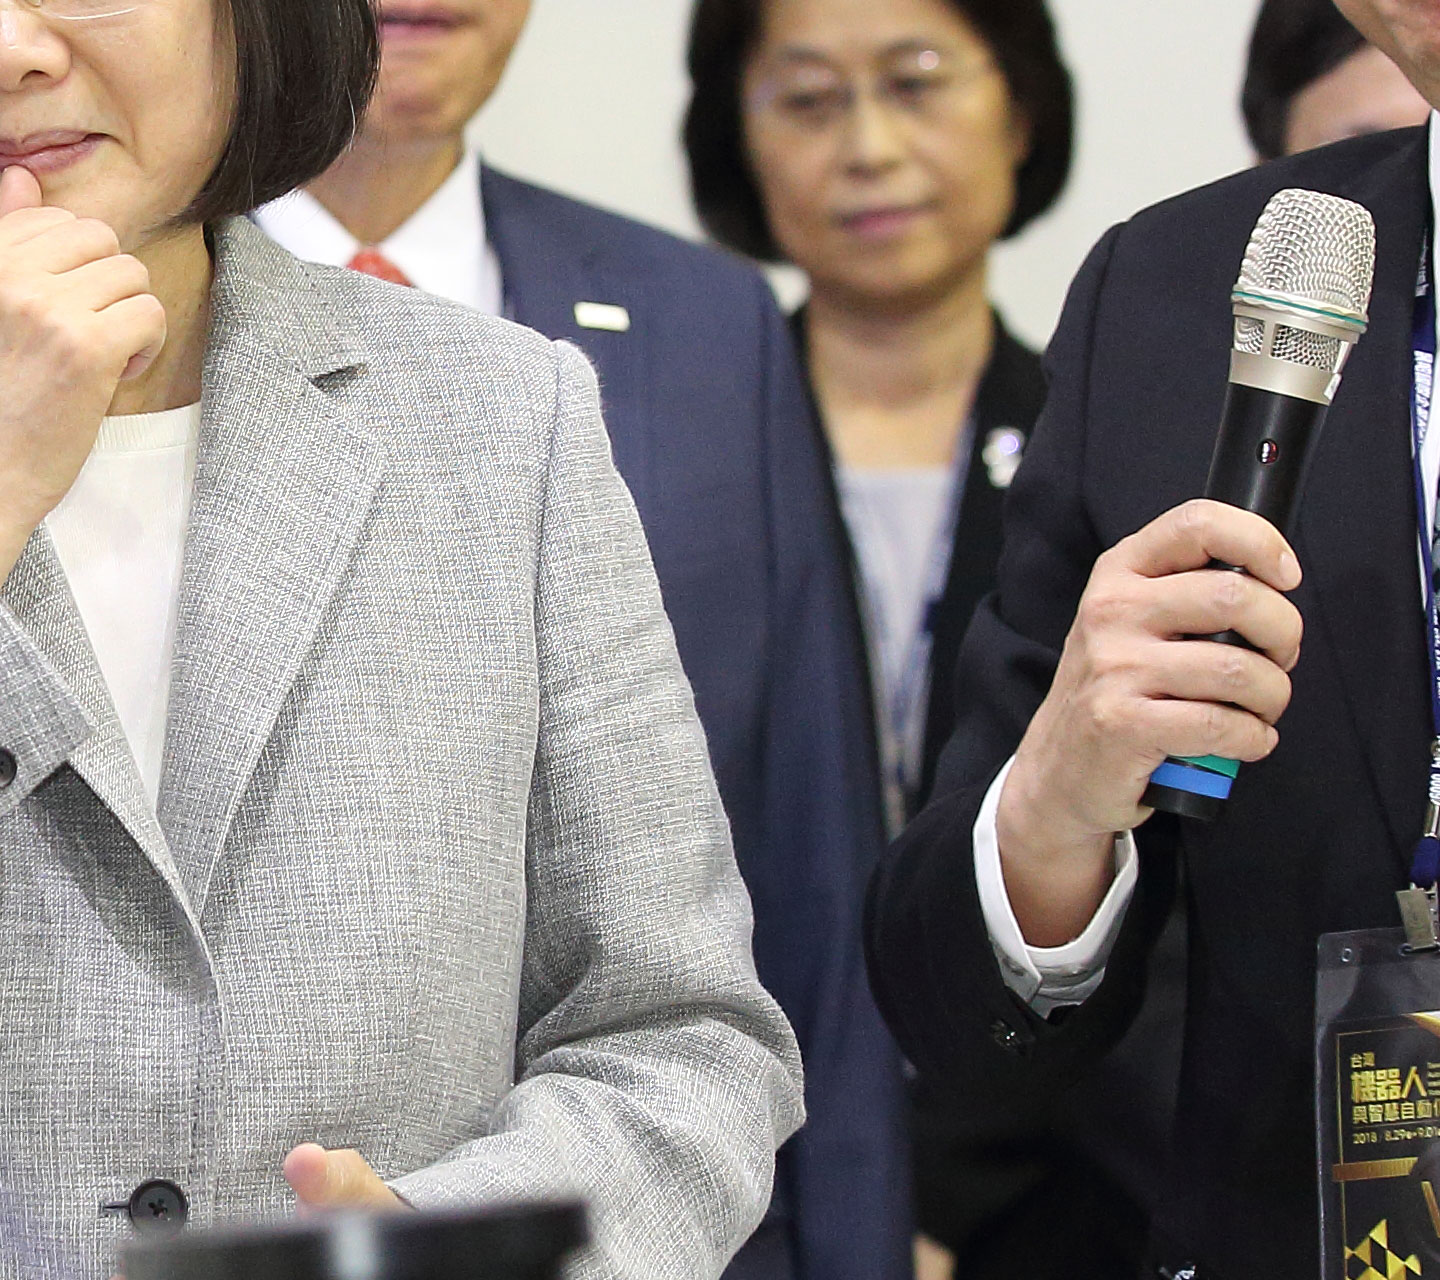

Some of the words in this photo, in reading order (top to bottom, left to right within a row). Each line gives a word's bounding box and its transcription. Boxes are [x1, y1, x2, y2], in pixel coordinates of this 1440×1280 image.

[1350, 1051, 1375, 1069] 台灣
[1350, 1065, 1428, 1103] 機器人
[1352, 1131, 1378, 1144] 2018
